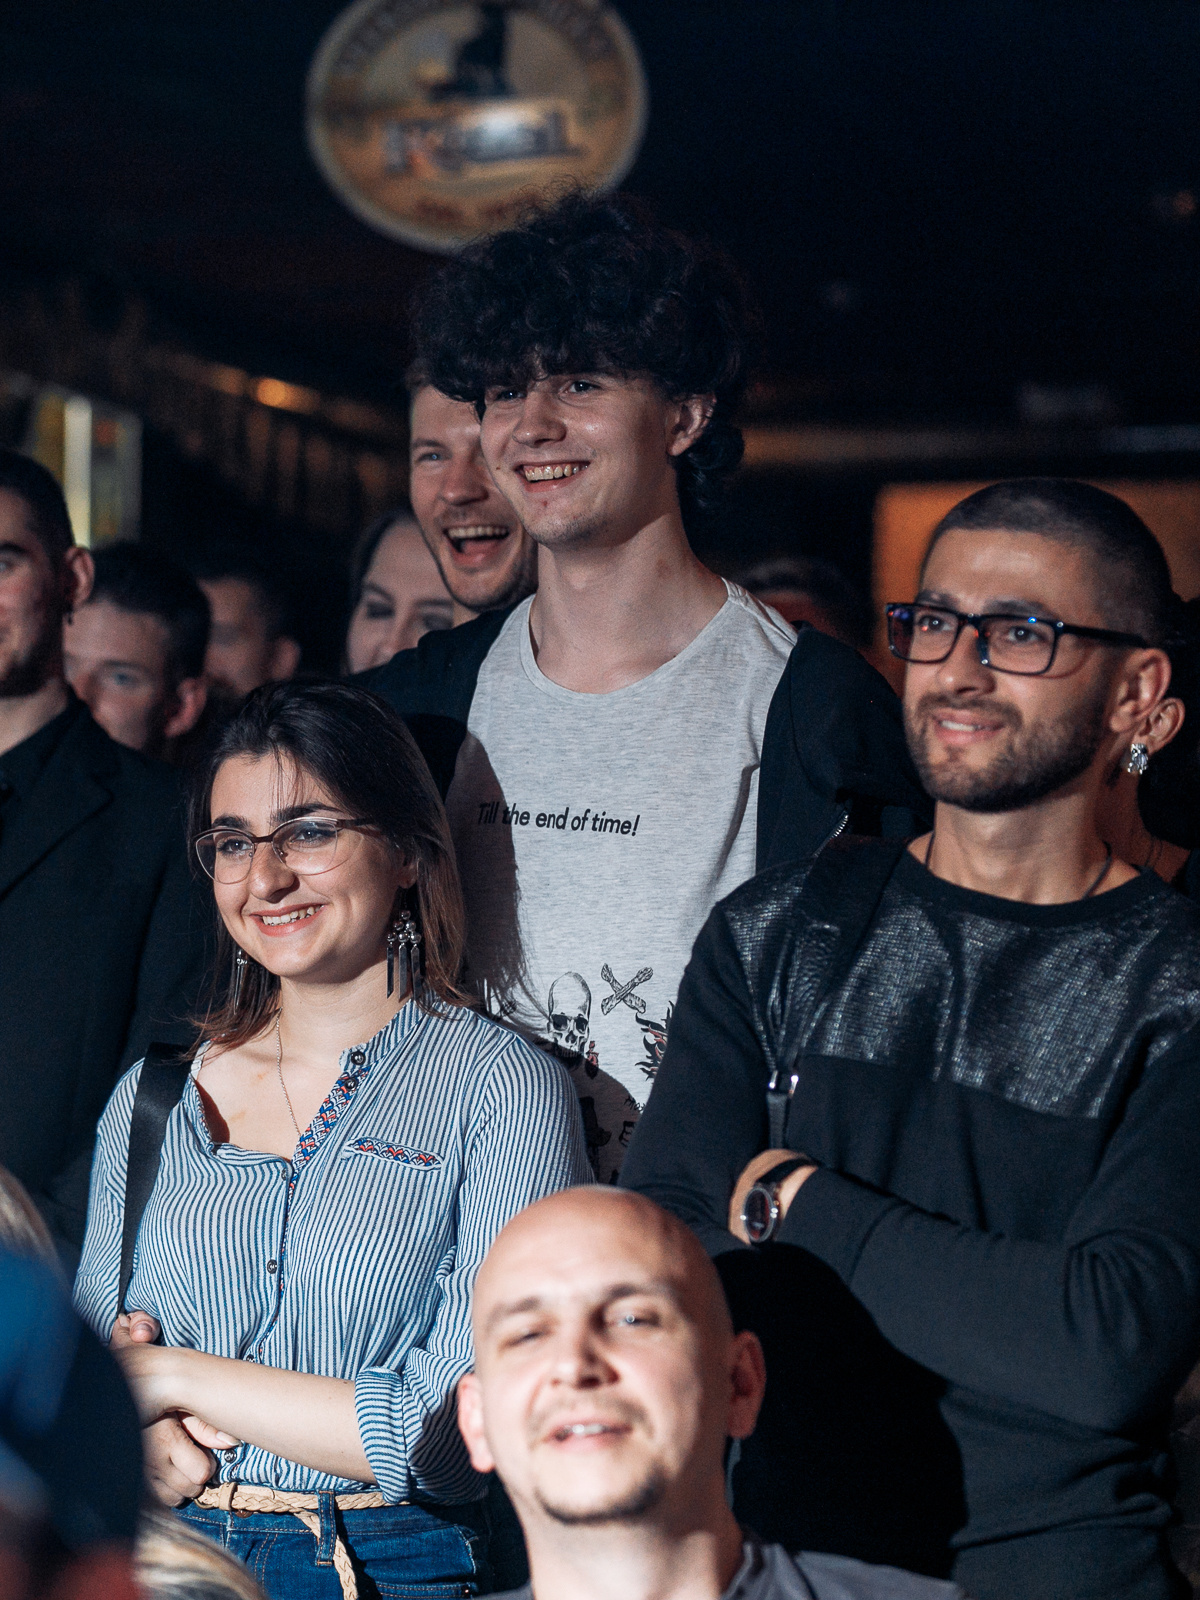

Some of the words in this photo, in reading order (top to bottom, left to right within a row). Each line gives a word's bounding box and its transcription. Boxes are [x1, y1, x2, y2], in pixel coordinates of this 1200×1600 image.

[478, 801, 499, 824] Till
[502, 803, 530, 826] the
[535, 807, 569, 829] end
[571, 808, 590, 831] of
[591, 811, 640, 837] time!
